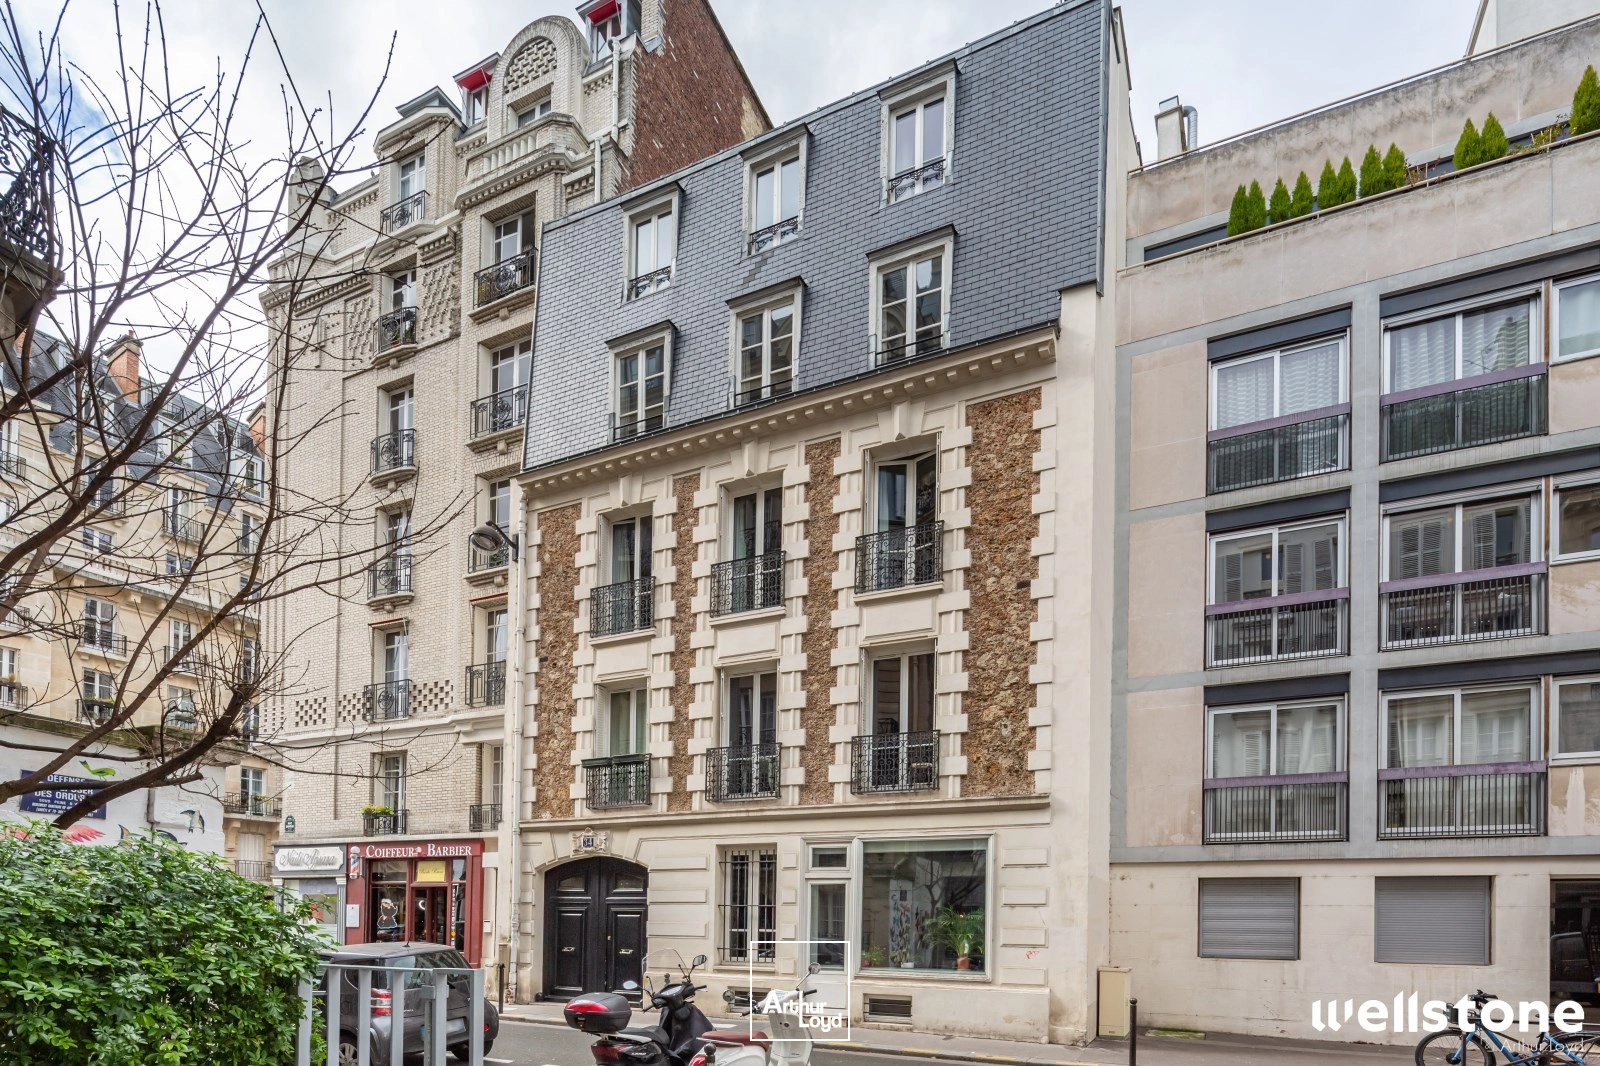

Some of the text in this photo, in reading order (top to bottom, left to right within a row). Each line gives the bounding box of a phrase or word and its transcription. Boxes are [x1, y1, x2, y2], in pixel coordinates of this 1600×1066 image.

[34, 790, 52, 798] DES
[583, 838, 592, 846] 34
[426, 842, 472, 857] BARBIER
